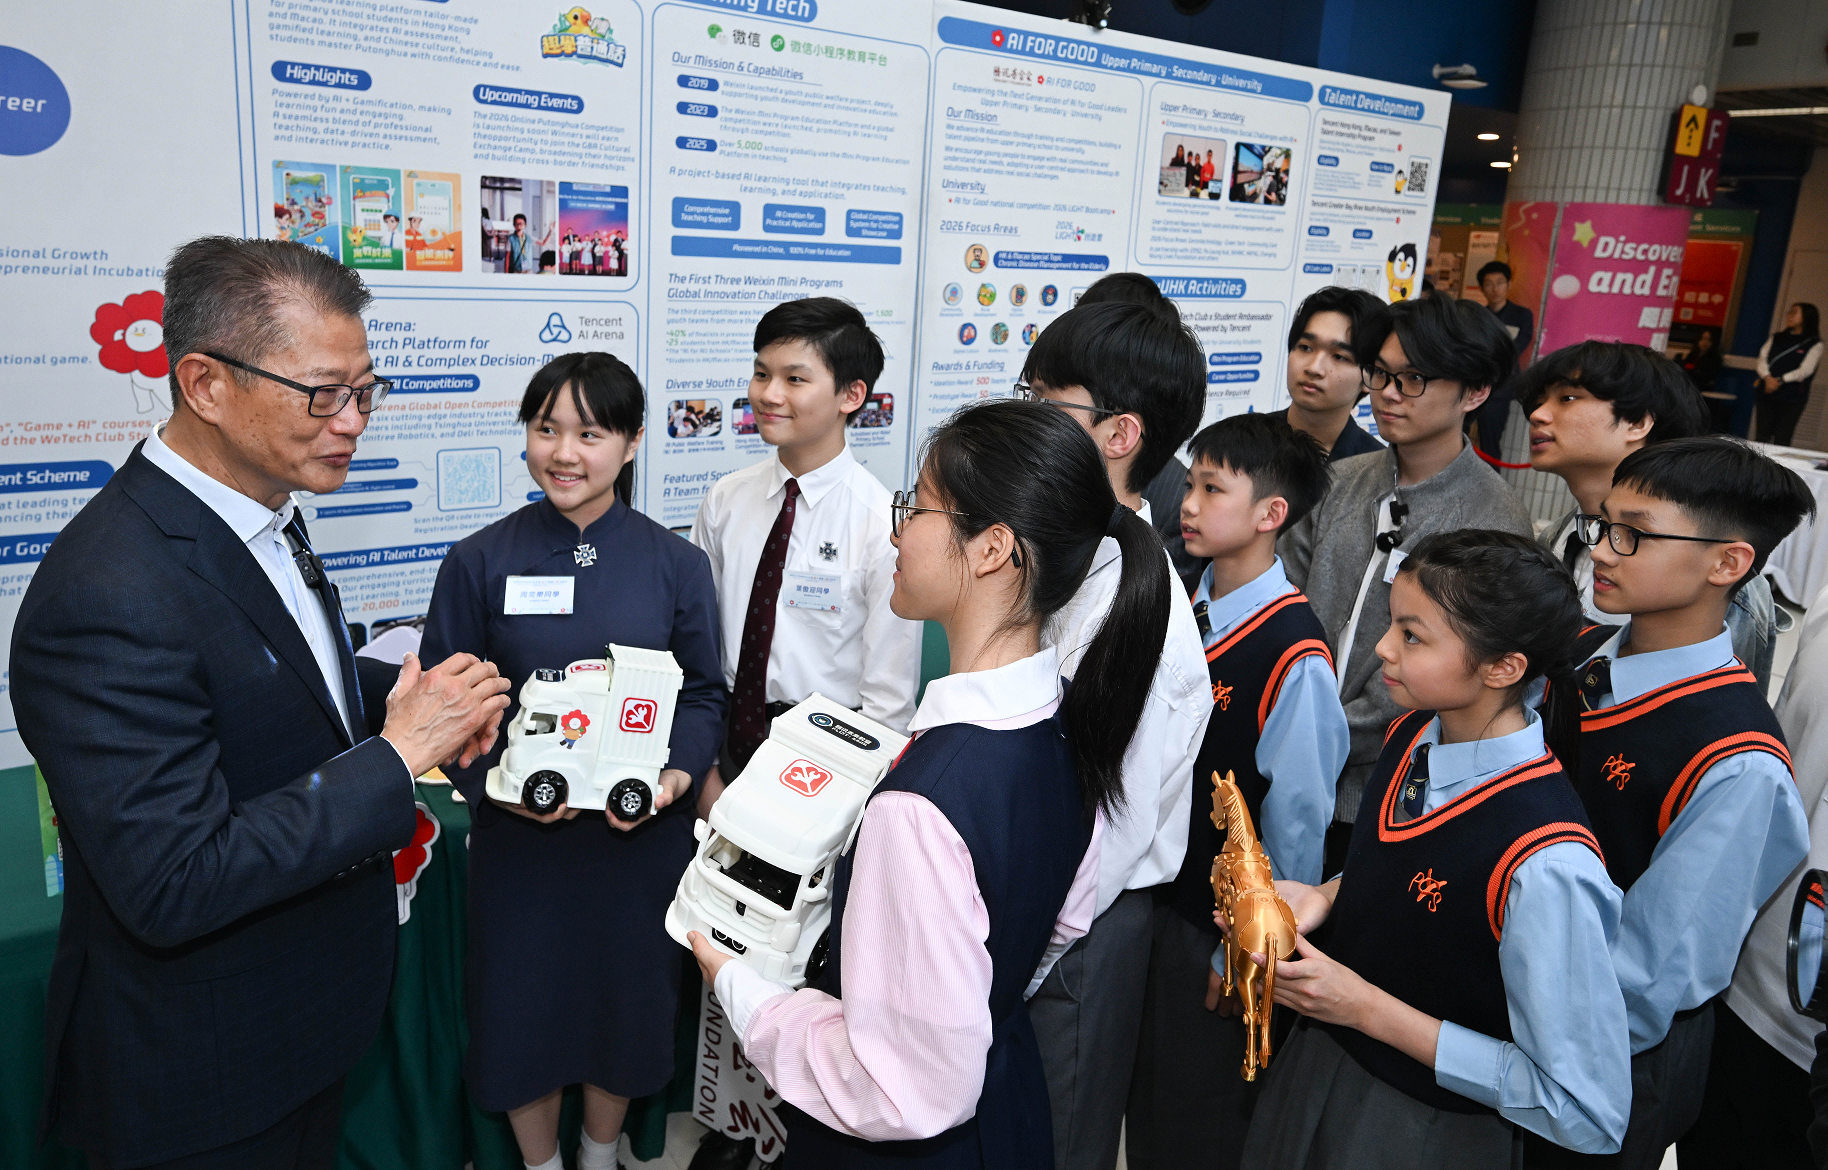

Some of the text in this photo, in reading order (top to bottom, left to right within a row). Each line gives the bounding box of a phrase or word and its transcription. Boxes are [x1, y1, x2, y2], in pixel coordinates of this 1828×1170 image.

[732, 29, 761, 48] 微信
[1007, 33, 1098, 63] AI FOR GOOD
[672, 51, 804, 80] Our Mission & Capabilities
[1101, 54, 1263, 92] Upper Primary Secondary University
[285, 64, 359, 86] Highlights
[688, 78, 708, 88] 2019
[1046, 76, 1058, 87] AI
[1057, 78, 1075, 89] FOR
[1074, 80, 1096, 93] GOOD
[479, 87, 578, 110] Upcoming Events
[1324, 88, 1420, 117] Talent Development
[687, 104, 708, 115] 2023
[946, 106, 998, 123] Our Mission
[1706, 120, 1722, 152] F
[686, 138, 707, 150] 2025
[736, 140, 764, 151] 5,000
[942, 178, 986, 194] University
[1674, 164, 1712, 200] J K
[780, 187, 797, 196] and
[940, 220, 1019, 234] 2026 Focus Areas
[50, 248, 109, 261] Growth
[1594, 235, 1684, 262] Discove
[668, 273, 844, 289] The First Three Weixin Mini Programs
[1159, 278, 1242, 295] UHK Activities
[1588, 265, 1657, 296] and
[667, 288, 810, 302] Global Innovation Challenges
[367, 319, 416, 332] Arena:
[578, 316, 623, 327] Tencent
[577, 330, 625, 340] AI Arena
[401, 337, 466, 350] Platform
[469, 337, 490, 350] for
[383, 355, 399, 368] AI
[401, 355, 413, 368] &
[416, 354, 477, 371] Complex
[931, 361, 1005, 372] Awards & Funding
[390, 377, 474, 392] AI Competitions
[666, 379, 703, 390] Diverse
[705, 378, 735, 389] Youth
[407, 401, 442, 411] Global
[443, 401, 469, 412] Open
[12, 435, 36, 446] the
[39, 432, 92, 445] WeTech
[95, 430, 125, 443] Club
[26, 469, 91, 485] Scheme
[663, 472, 709, 484] Featured
[663, 486, 700, 498] A Team
[15, 498, 69, 509] leading
[0, 512, 42, 524] ncing
[368, 552, 381, 564] AI
[383, 548, 416, 562] Talent
[361, 598, 400, 612] 20,000
